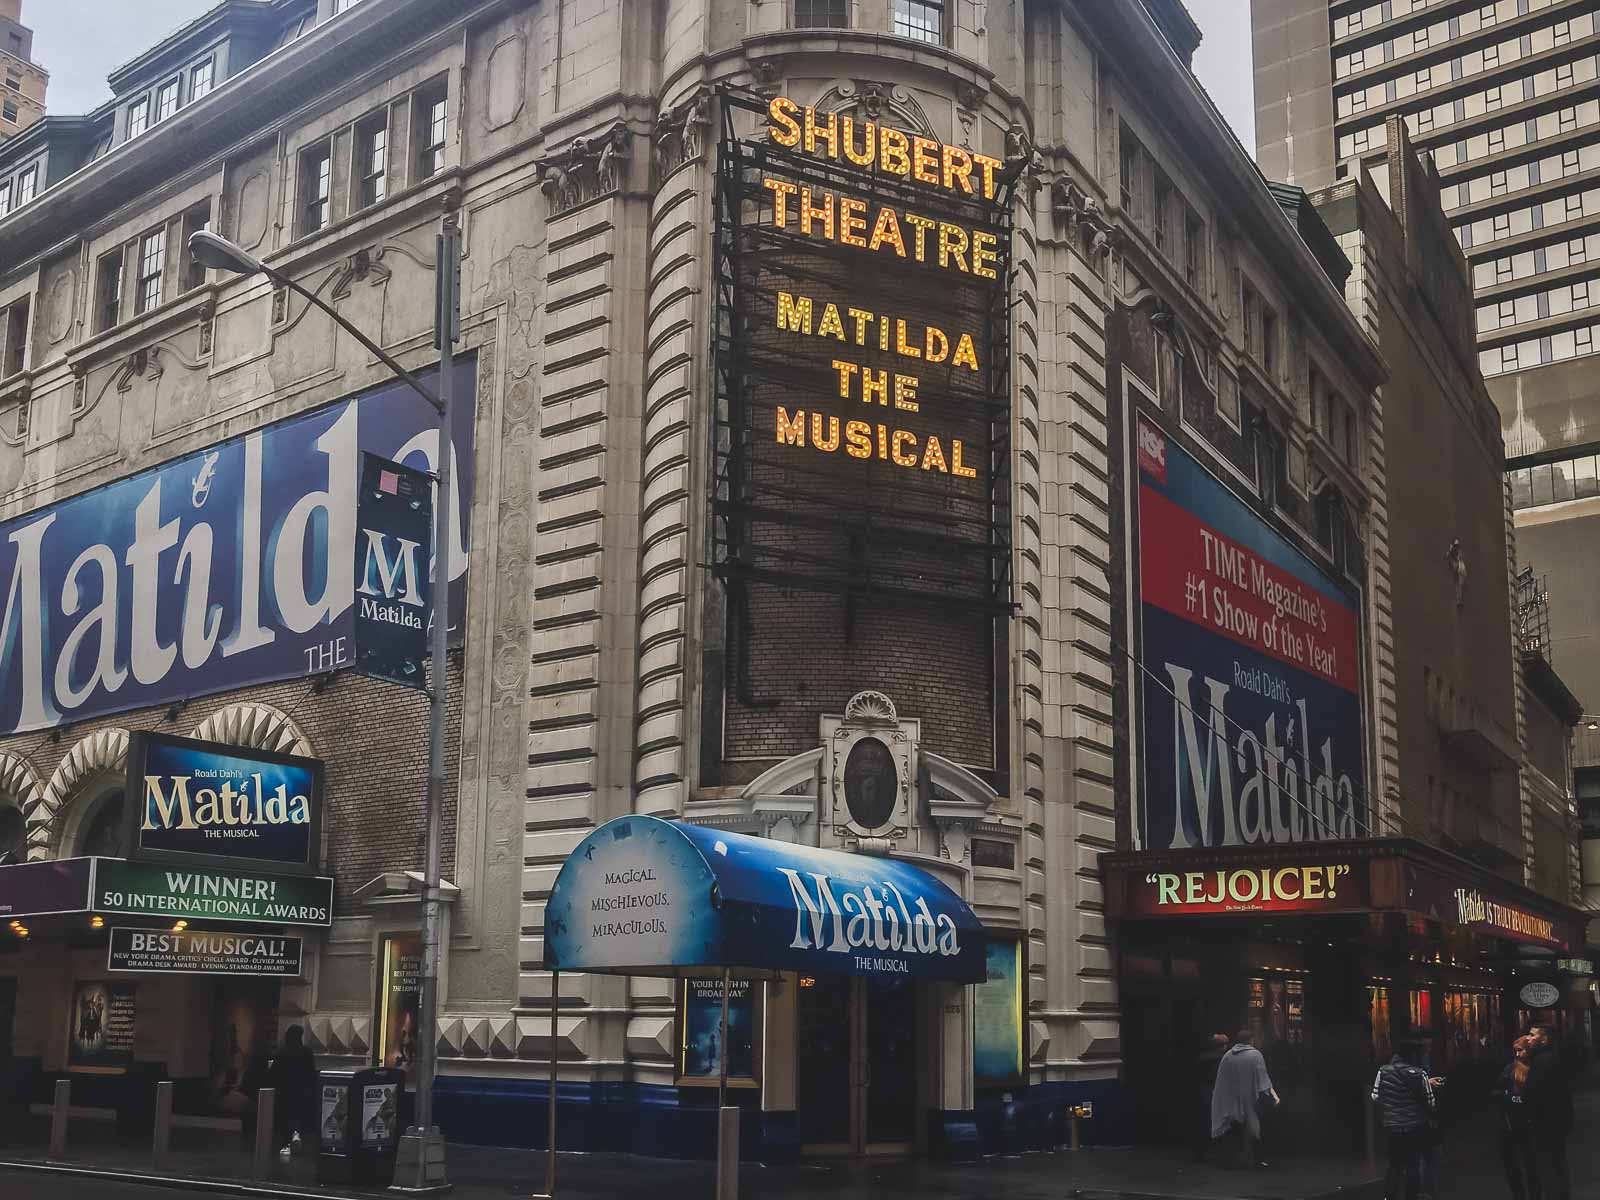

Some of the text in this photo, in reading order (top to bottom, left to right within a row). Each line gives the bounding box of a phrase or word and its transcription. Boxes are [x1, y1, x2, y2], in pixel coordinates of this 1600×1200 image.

[767, 97, 1002, 200] SHUBERT
[763, 177, 997, 279] THEATRE
[777, 291, 978, 371] MATILDA
[832, 359, 919, 412] THE
[776, 406, 977, 478] MUSICAL
[356, 528, 424, 607] M
[1199, 528, 1327, 632] TIME Magazine's
[360, 597, 422, 630] Matilda
[1185, 571, 1337, 679] #1 Show of the Year!
[304, 636, 347, 673] THE
[1233, 660, 1291, 705] Roald Dahl's
[1164, 662, 1357, 849] Matilda
[195, 768, 243, 779] Roald Dahl's
[141, 773, 311, 830] Matilda
[204, 829, 260, 839] THE MUSICAL
[165, 872, 277, 901] WINNER!
[605, 869, 657, 885] MAGICAL.
[103, 891, 327, 920] 50 INTERNATIONAL AWARDS
[591, 892, 670, 911] MISCHIEVOUS.
[776, 866, 961, 956] Matilda
[1486, 900, 1493, 924] IS
[1493, 903, 1511, 929] TRULY
[113, 952, 130, 960] NEW
[131, 952, 149, 961] YORK
[150, 953, 176, 961] DRAMA
[203, 955, 224, 963] CIRCLE
[226, 956, 249, 964] AWARD
[252, 957, 274, 965] OLIVIER
[274, 958, 297, 966] AWARD
[130, 933, 286, 957] BEST MUSICAL!
[127, 960, 285, 972] DRAMA DESK AWARD EVENING STANDARD AWARD
[854, 956, 909, 973] THE MUSICAL
[692, 980, 749, 989] YOUR FATH IN
